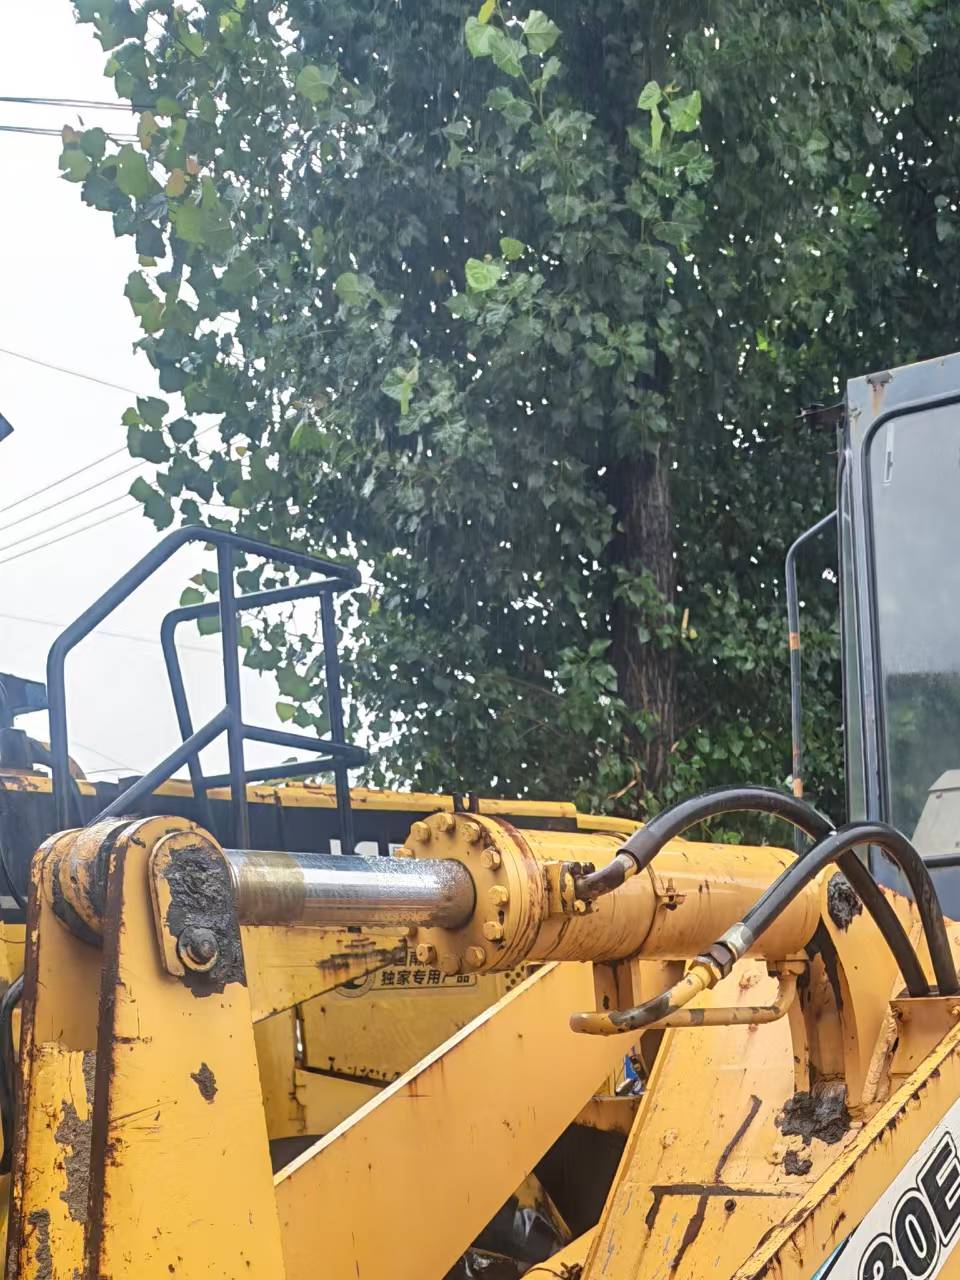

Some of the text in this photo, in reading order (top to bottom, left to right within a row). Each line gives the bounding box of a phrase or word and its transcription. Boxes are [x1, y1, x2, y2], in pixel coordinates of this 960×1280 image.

[381, 969, 470, 986] 独家专用品
